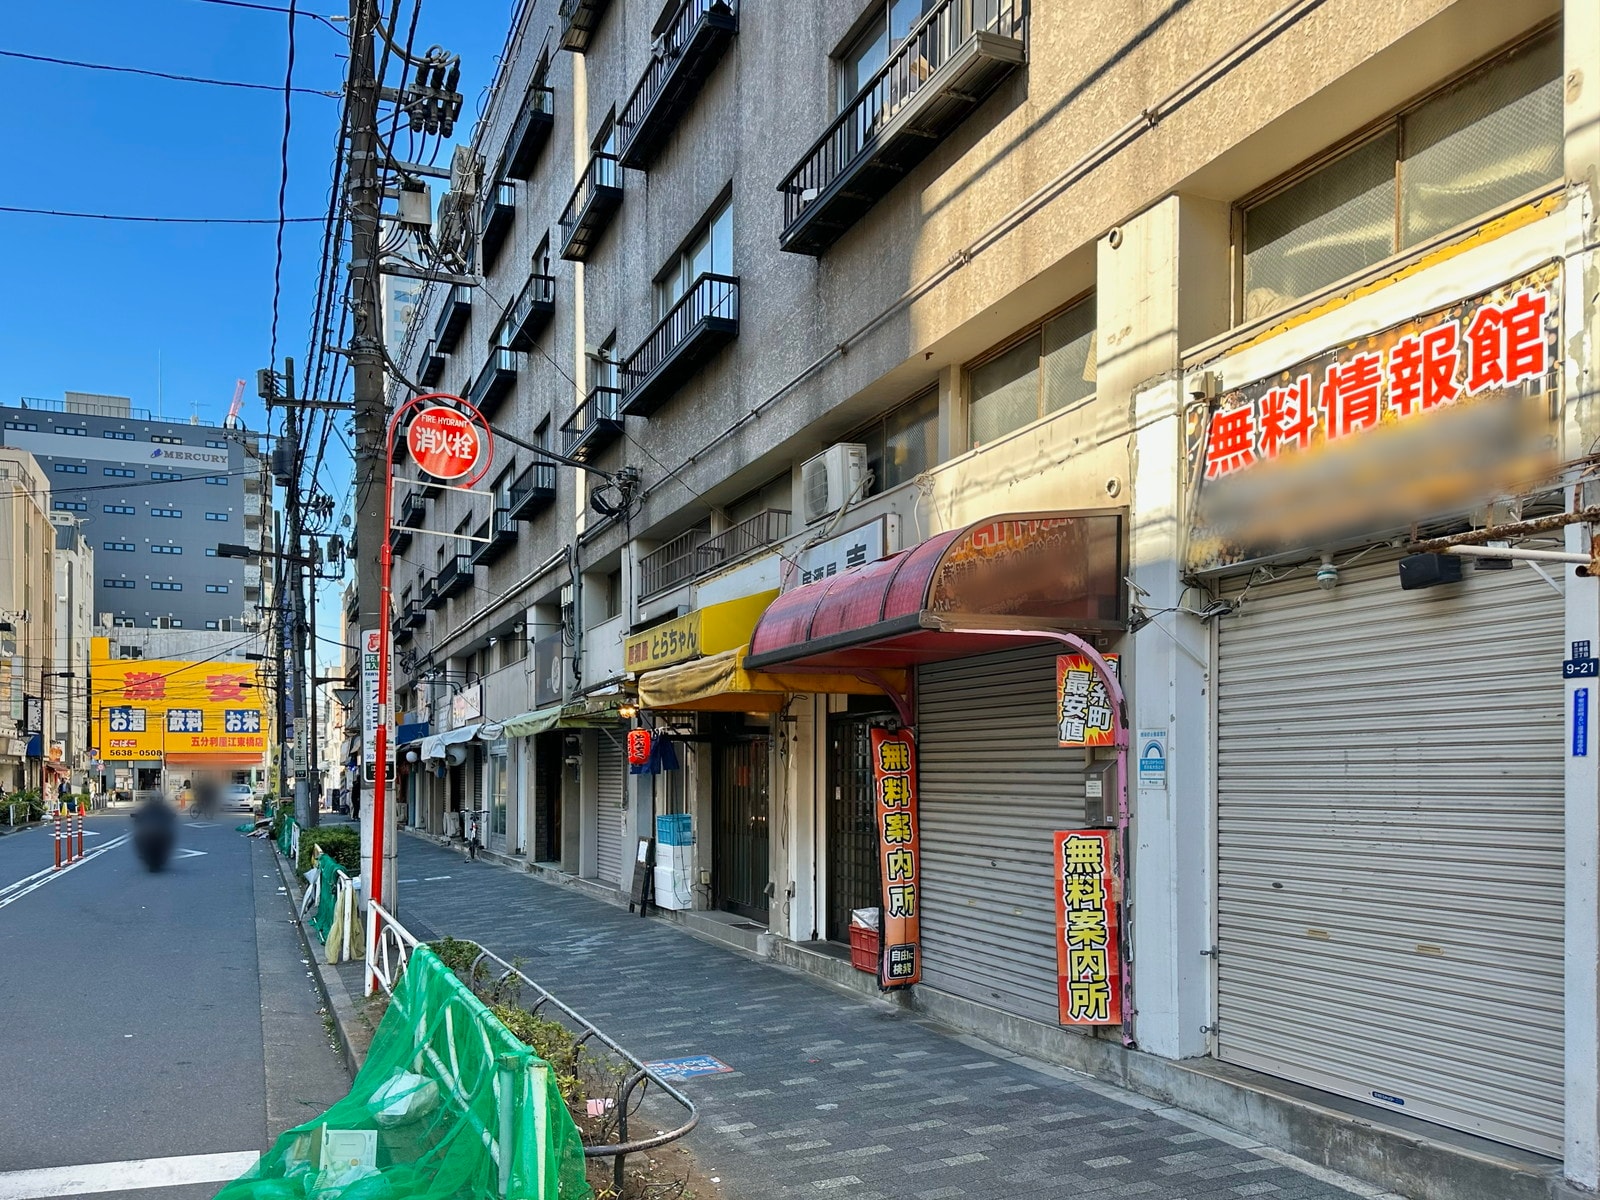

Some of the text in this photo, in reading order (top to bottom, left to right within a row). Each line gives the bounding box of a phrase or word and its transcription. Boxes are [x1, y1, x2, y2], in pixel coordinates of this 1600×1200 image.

[1204, 290, 1548, 479] 無料情報館
[421, 414, 467, 428] FIRE HYDRANT
[415, 425, 474, 460] 消火栓
[163, 450, 228, 463] MERCURY
[651, 622, 697, 660] とらちゃん
[1566, 662, 1594, 674] 9-21
[1059, 669, 1091, 742] 最安値
[110, 709, 146, 732] お酒
[168, 709, 203, 732] 飲料
[226, 710, 260, 732] お米
[110, 739, 137, 748] たばこ
[110, 749, 163, 757] 5638-0508
[191, 736, 264, 748] 五分利屋江東橋店
[878, 740, 915, 918] 無料案内所
[1063, 835, 1109, 1020] 無料案内所
[892, 950, 914, 962] 自由に
[893, 962, 912, 975] 検索
